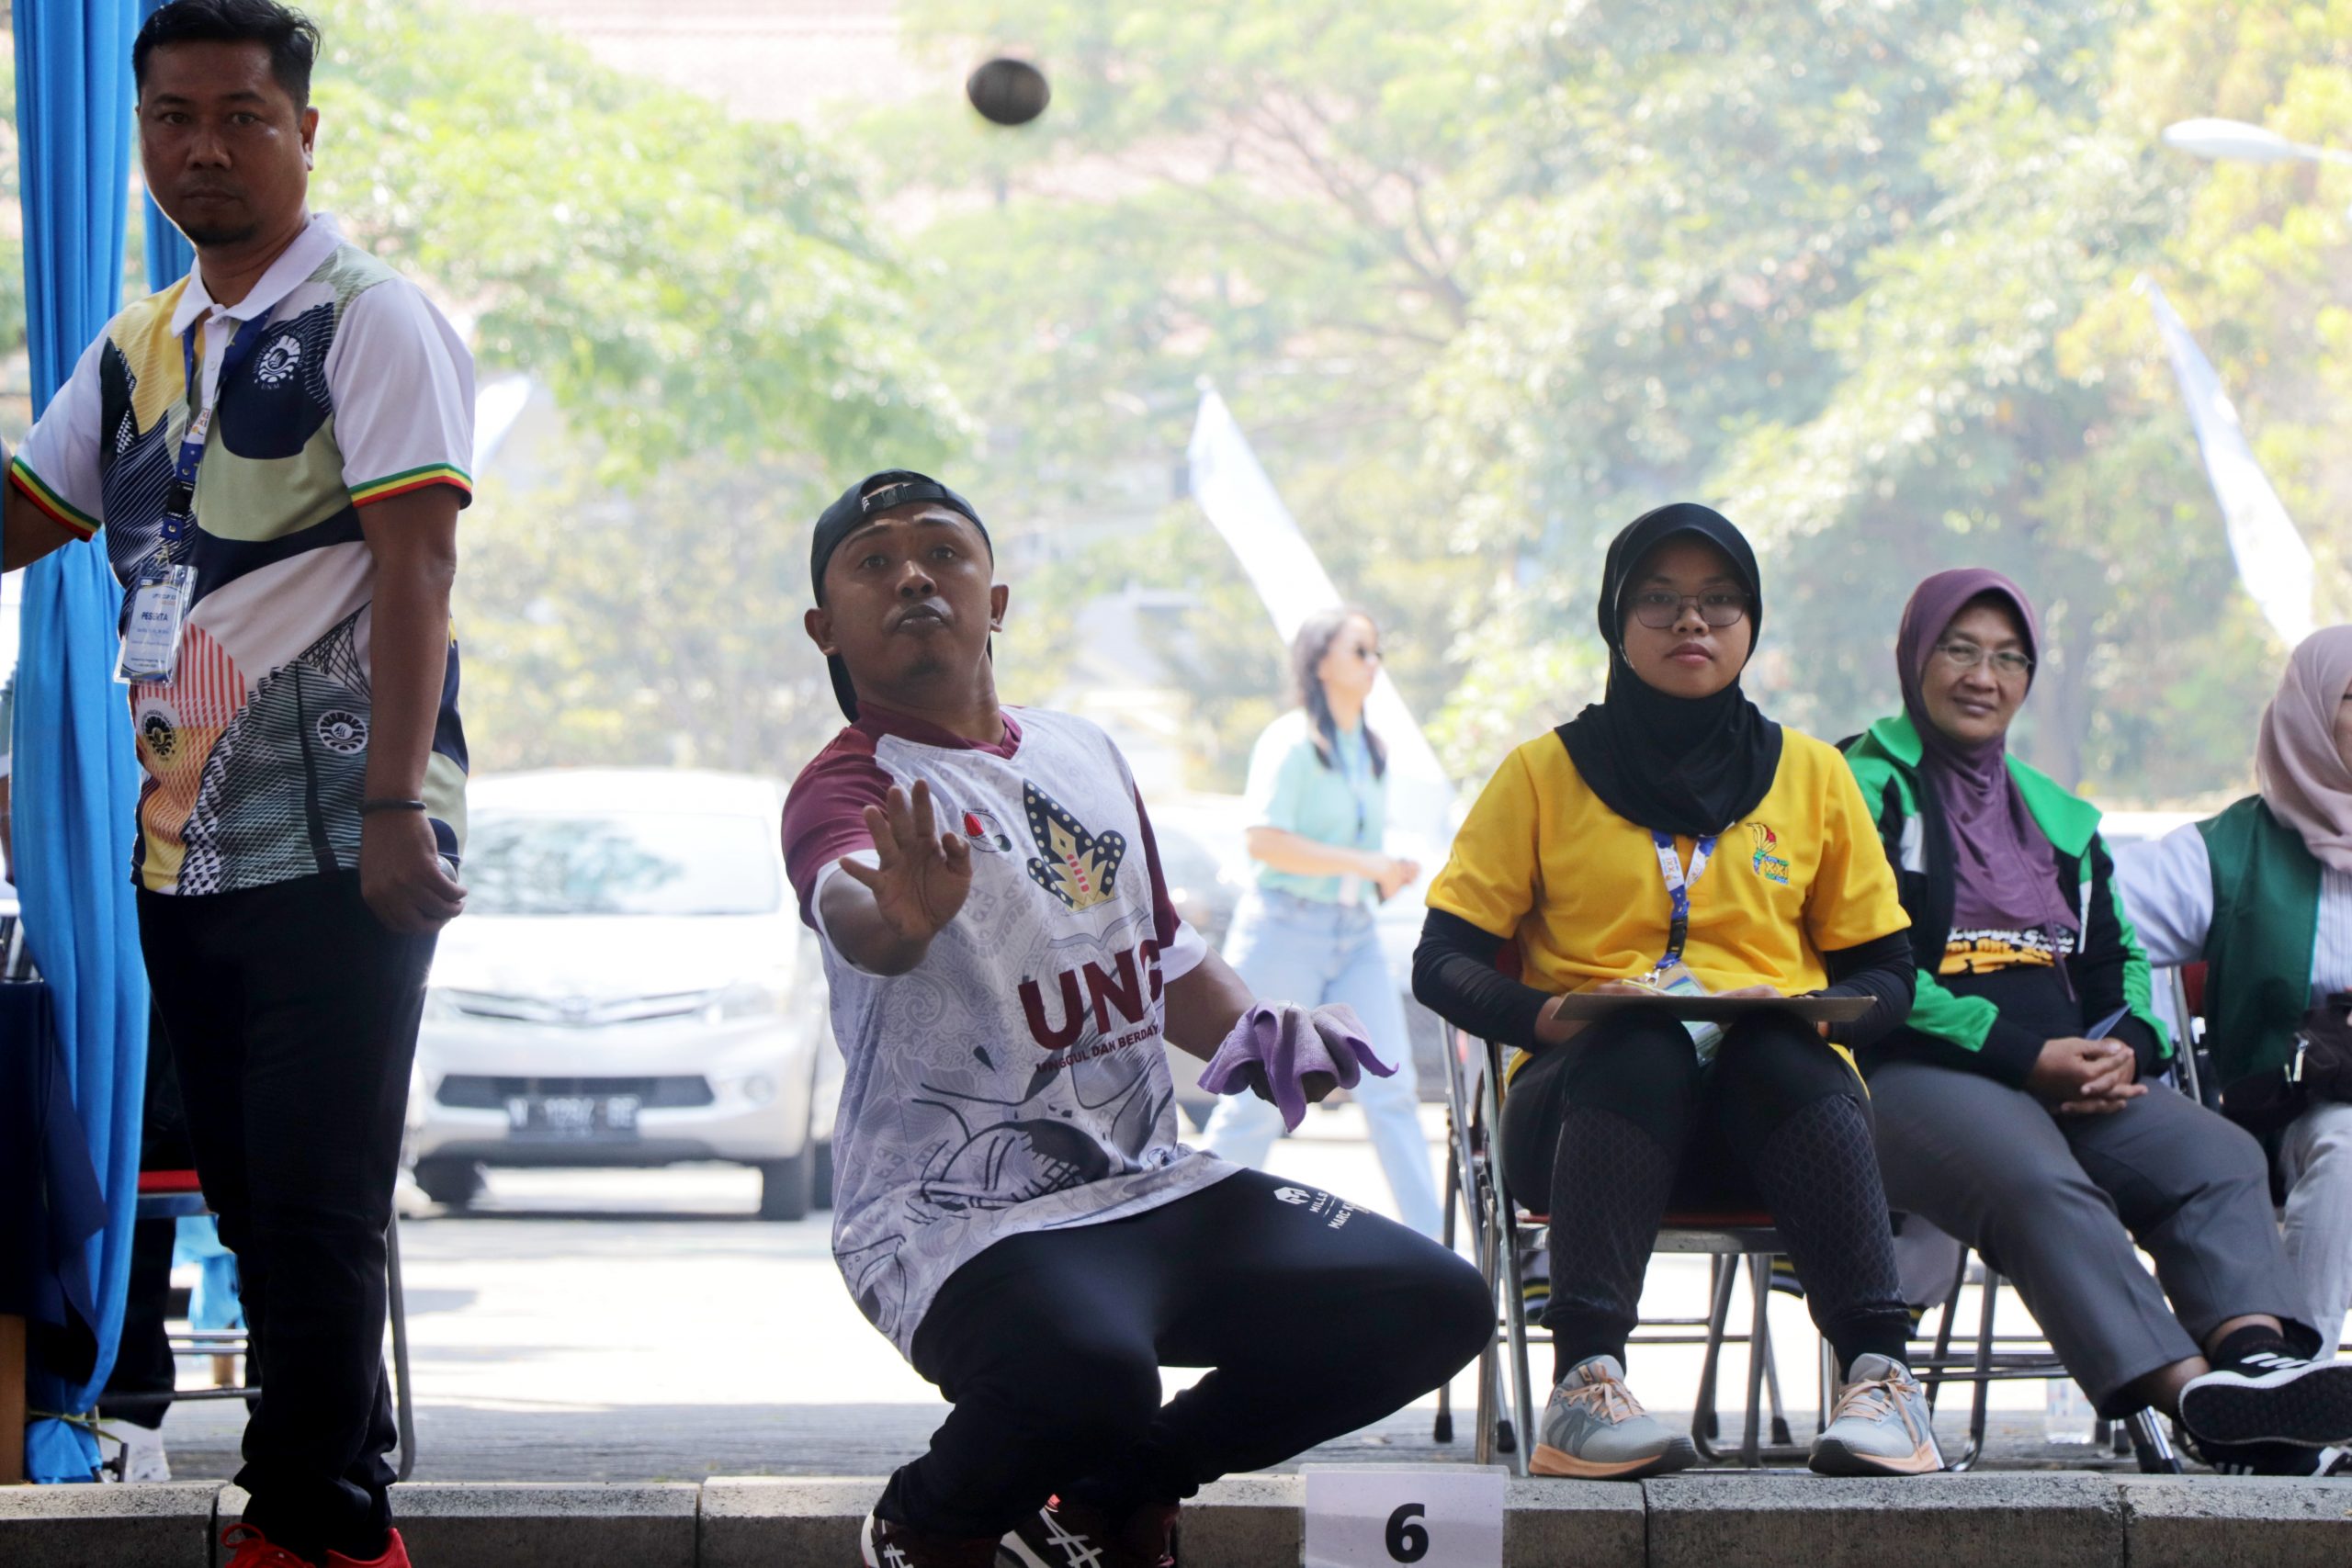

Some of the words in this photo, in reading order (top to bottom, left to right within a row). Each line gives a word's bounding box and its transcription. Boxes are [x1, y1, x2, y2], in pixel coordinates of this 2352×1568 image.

[1035, 1050, 1091, 1074] UNGGUL
[1091, 1040, 1117, 1057] DAN
[1117, 1023, 1162, 1049] BERDAY
[1308, 1191, 1329, 1213] MILLS
[1327, 1209, 1351, 1230] MARC
[1385, 1502, 1430, 1564] 6
